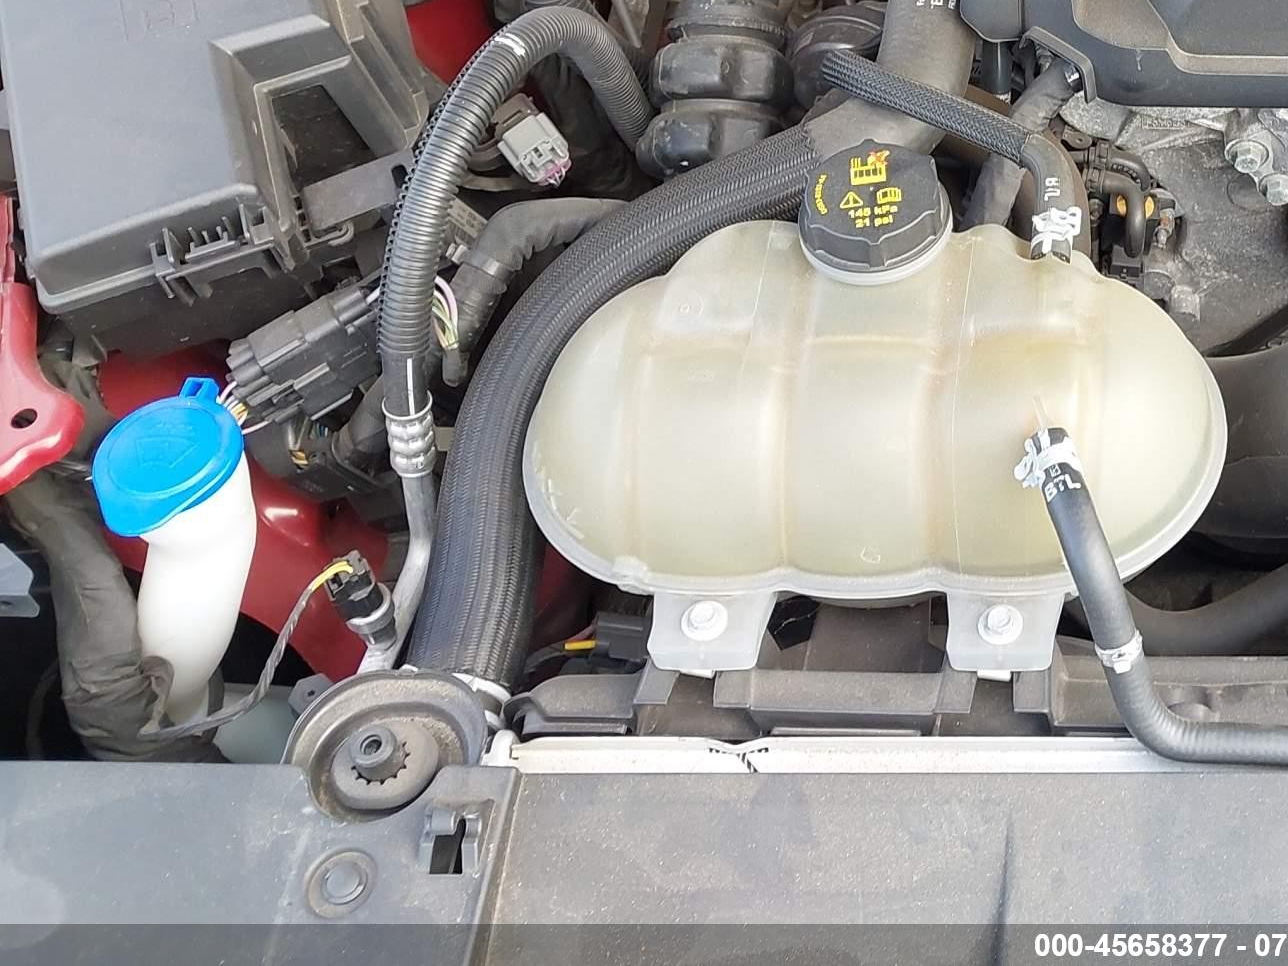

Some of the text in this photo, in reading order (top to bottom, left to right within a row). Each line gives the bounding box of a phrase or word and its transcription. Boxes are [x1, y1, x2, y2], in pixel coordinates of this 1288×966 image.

[874, 205, 899, 216] kPa
[855, 215, 894, 228] 21 psi
